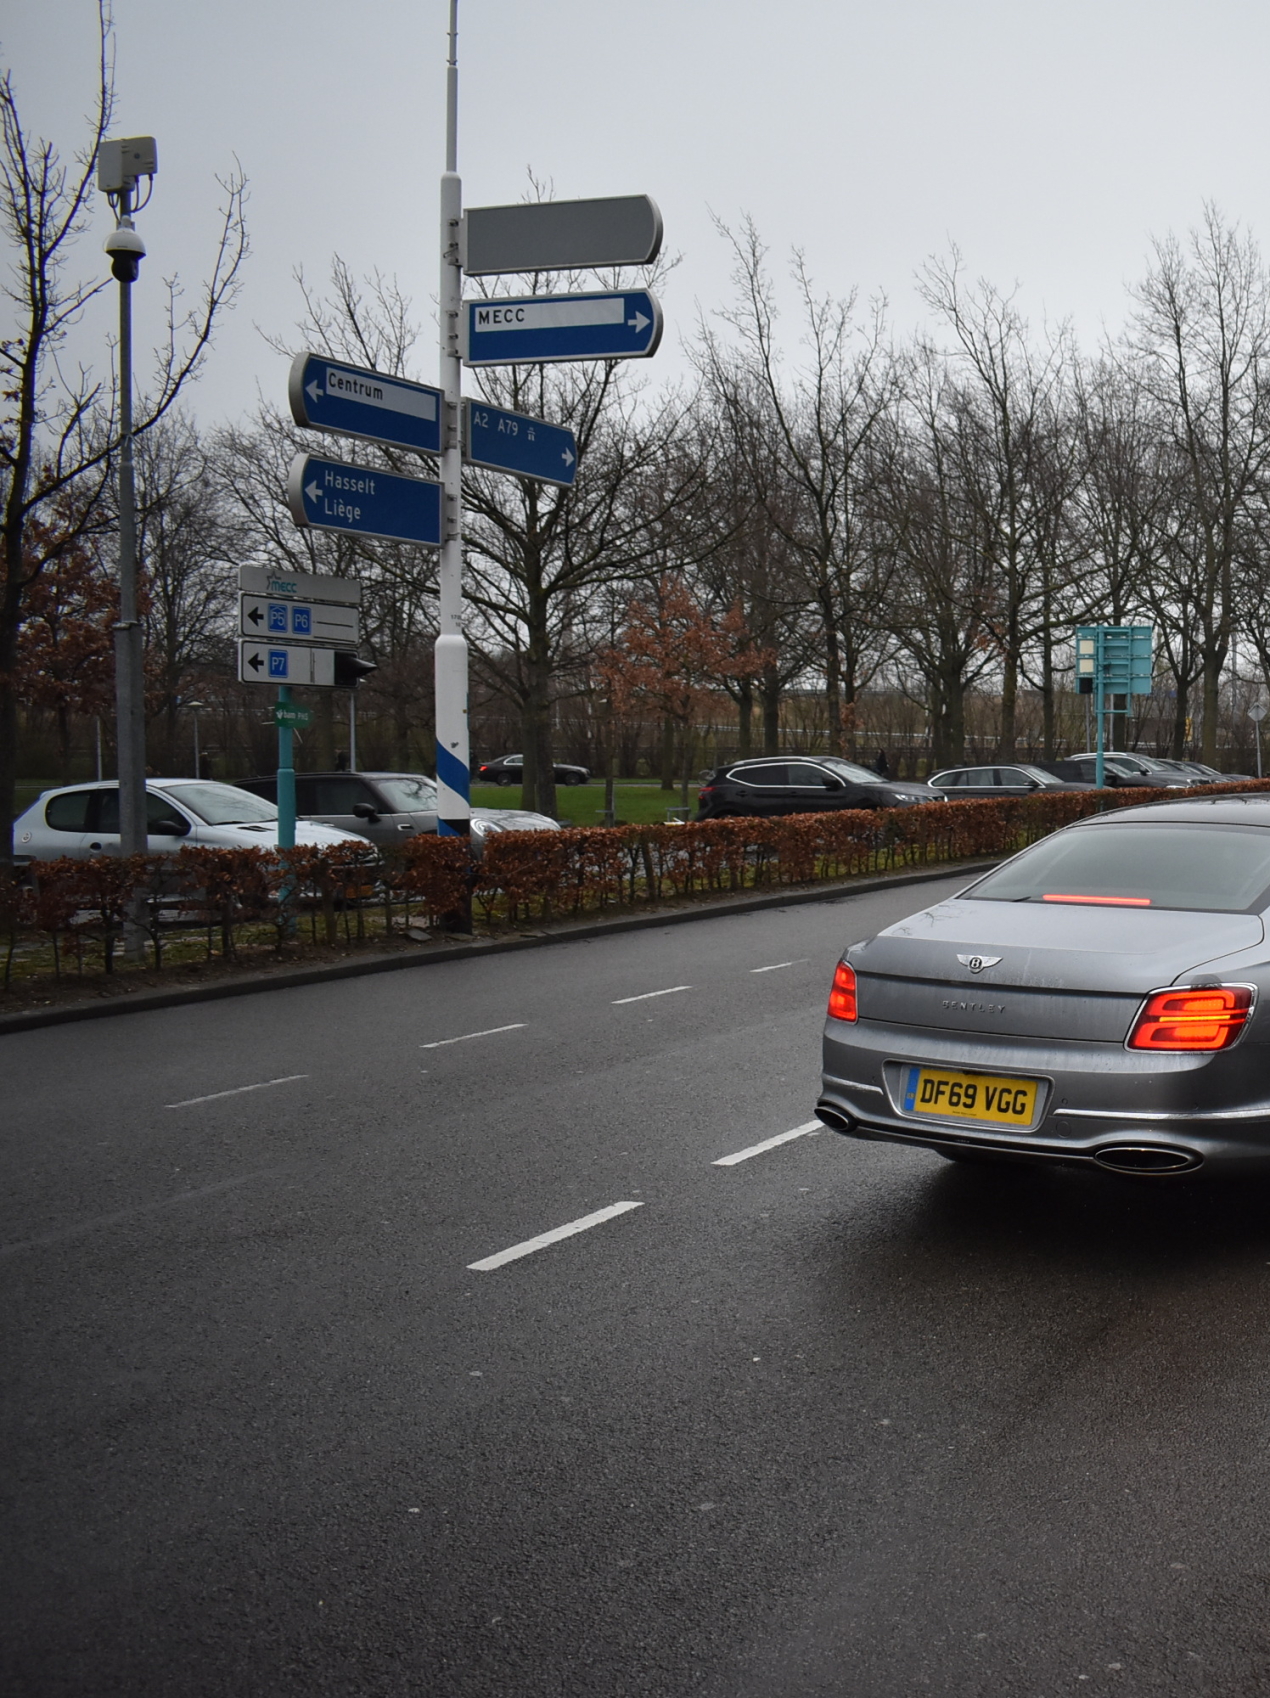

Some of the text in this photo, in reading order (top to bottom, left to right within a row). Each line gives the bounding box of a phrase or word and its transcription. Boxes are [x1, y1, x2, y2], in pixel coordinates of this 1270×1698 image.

[478, 308, 525, 325] MECC
[328, 372, 384, 401] Centrum
[473, 411, 519, 436] A2 A79
[324, 469, 376, 495] Hasselt
[324, 498, 362, 523] Liège
[271, 611, 309, 628] P5 P6
[271, 656, 286, 670] P7
[942, 1000, 1006, 1014] BENTLEY
[920, 1078, 1028, 1115] DF69 VGG
